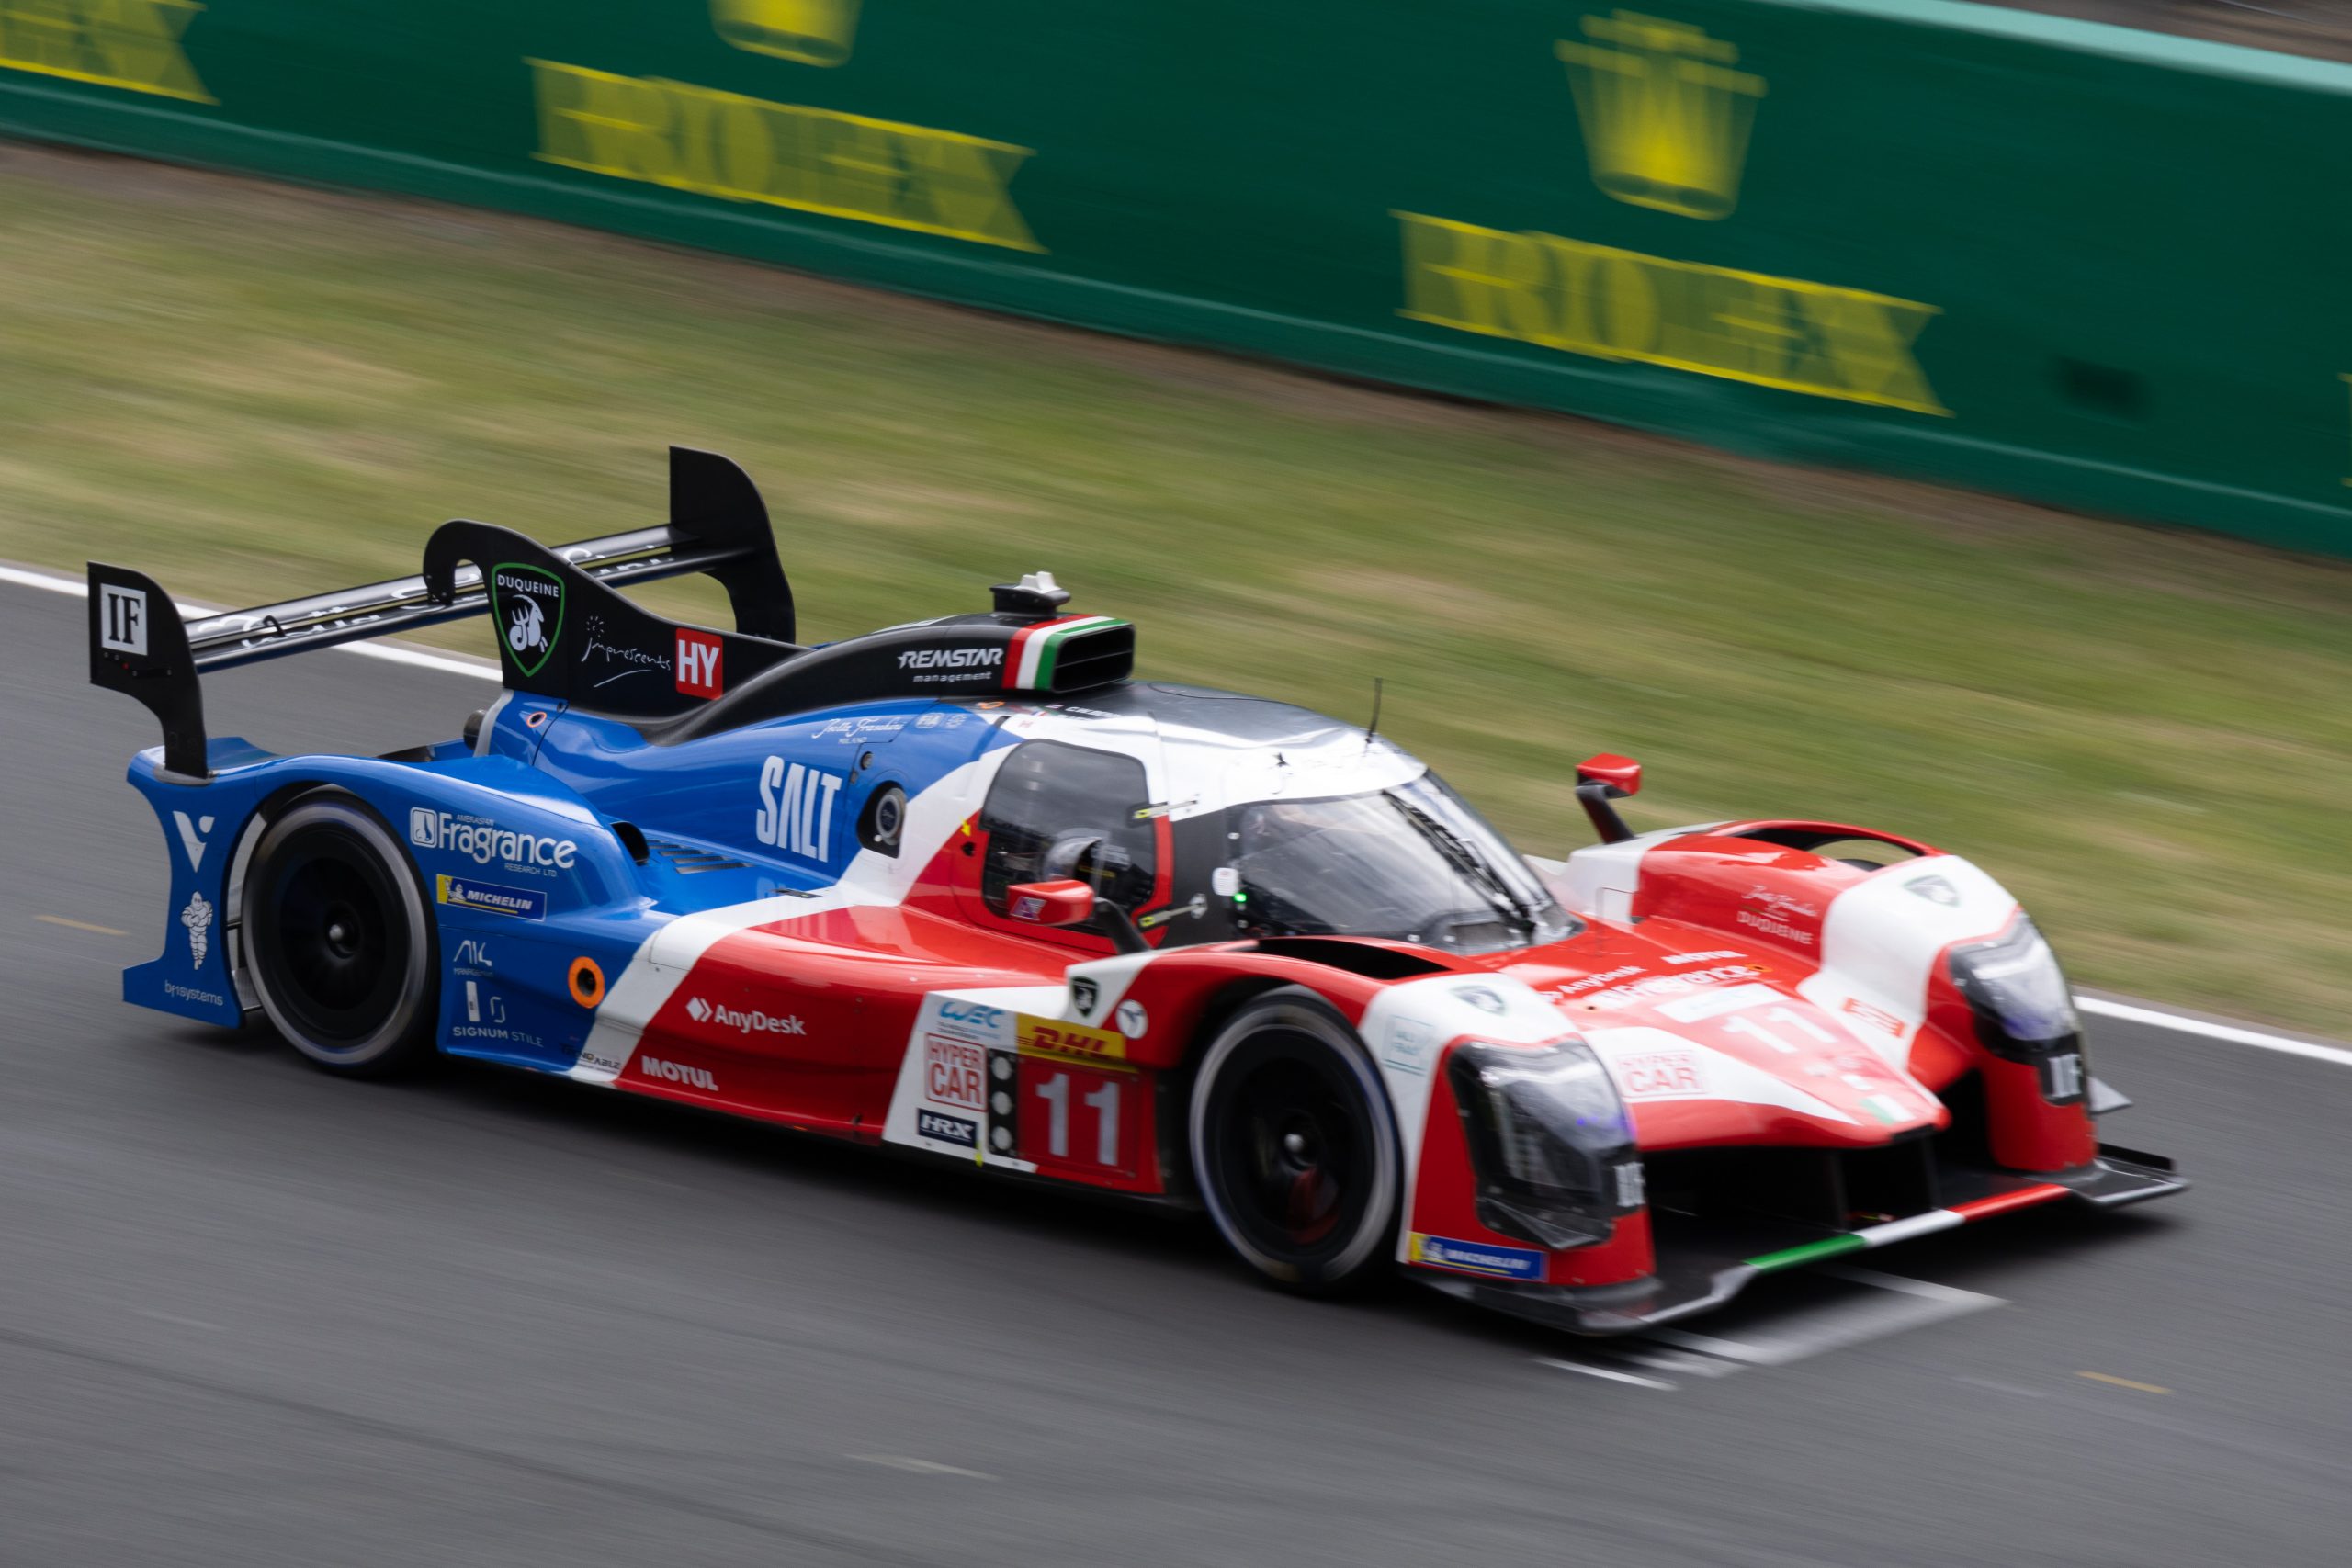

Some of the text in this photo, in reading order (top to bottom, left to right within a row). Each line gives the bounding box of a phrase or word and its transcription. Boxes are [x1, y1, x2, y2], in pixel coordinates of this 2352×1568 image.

[497, 573, 560, 597] DUQUEINE
[107, 592, 141, 644] IF
[678, 638, 720, 687] HY
[898, 647, 1005, 669] REMSTAR
[912, 671, 992, 683] management
[756, 755, 842, 863] SALT
[439, 812, 578, 869] Fragrance
[467, 889, 533, 910] MICHELIN
[714, 1003, 808, 1035] AnyDesk
[453, 1026, 545, 1048] SIGNUM STILE
[1029, 1025, 1109, 1056] DHL
[927, 1043, 980, 1067] HYPER
[641, 1055, 719, 1091] MOTUL
[929, 1063, 981, 1103] CAR
[1626, 1066, 1703, 1092] CAR
[922, 1113, 974, 1141] HRX
[1035, 1072, 1120, 1167] 11
